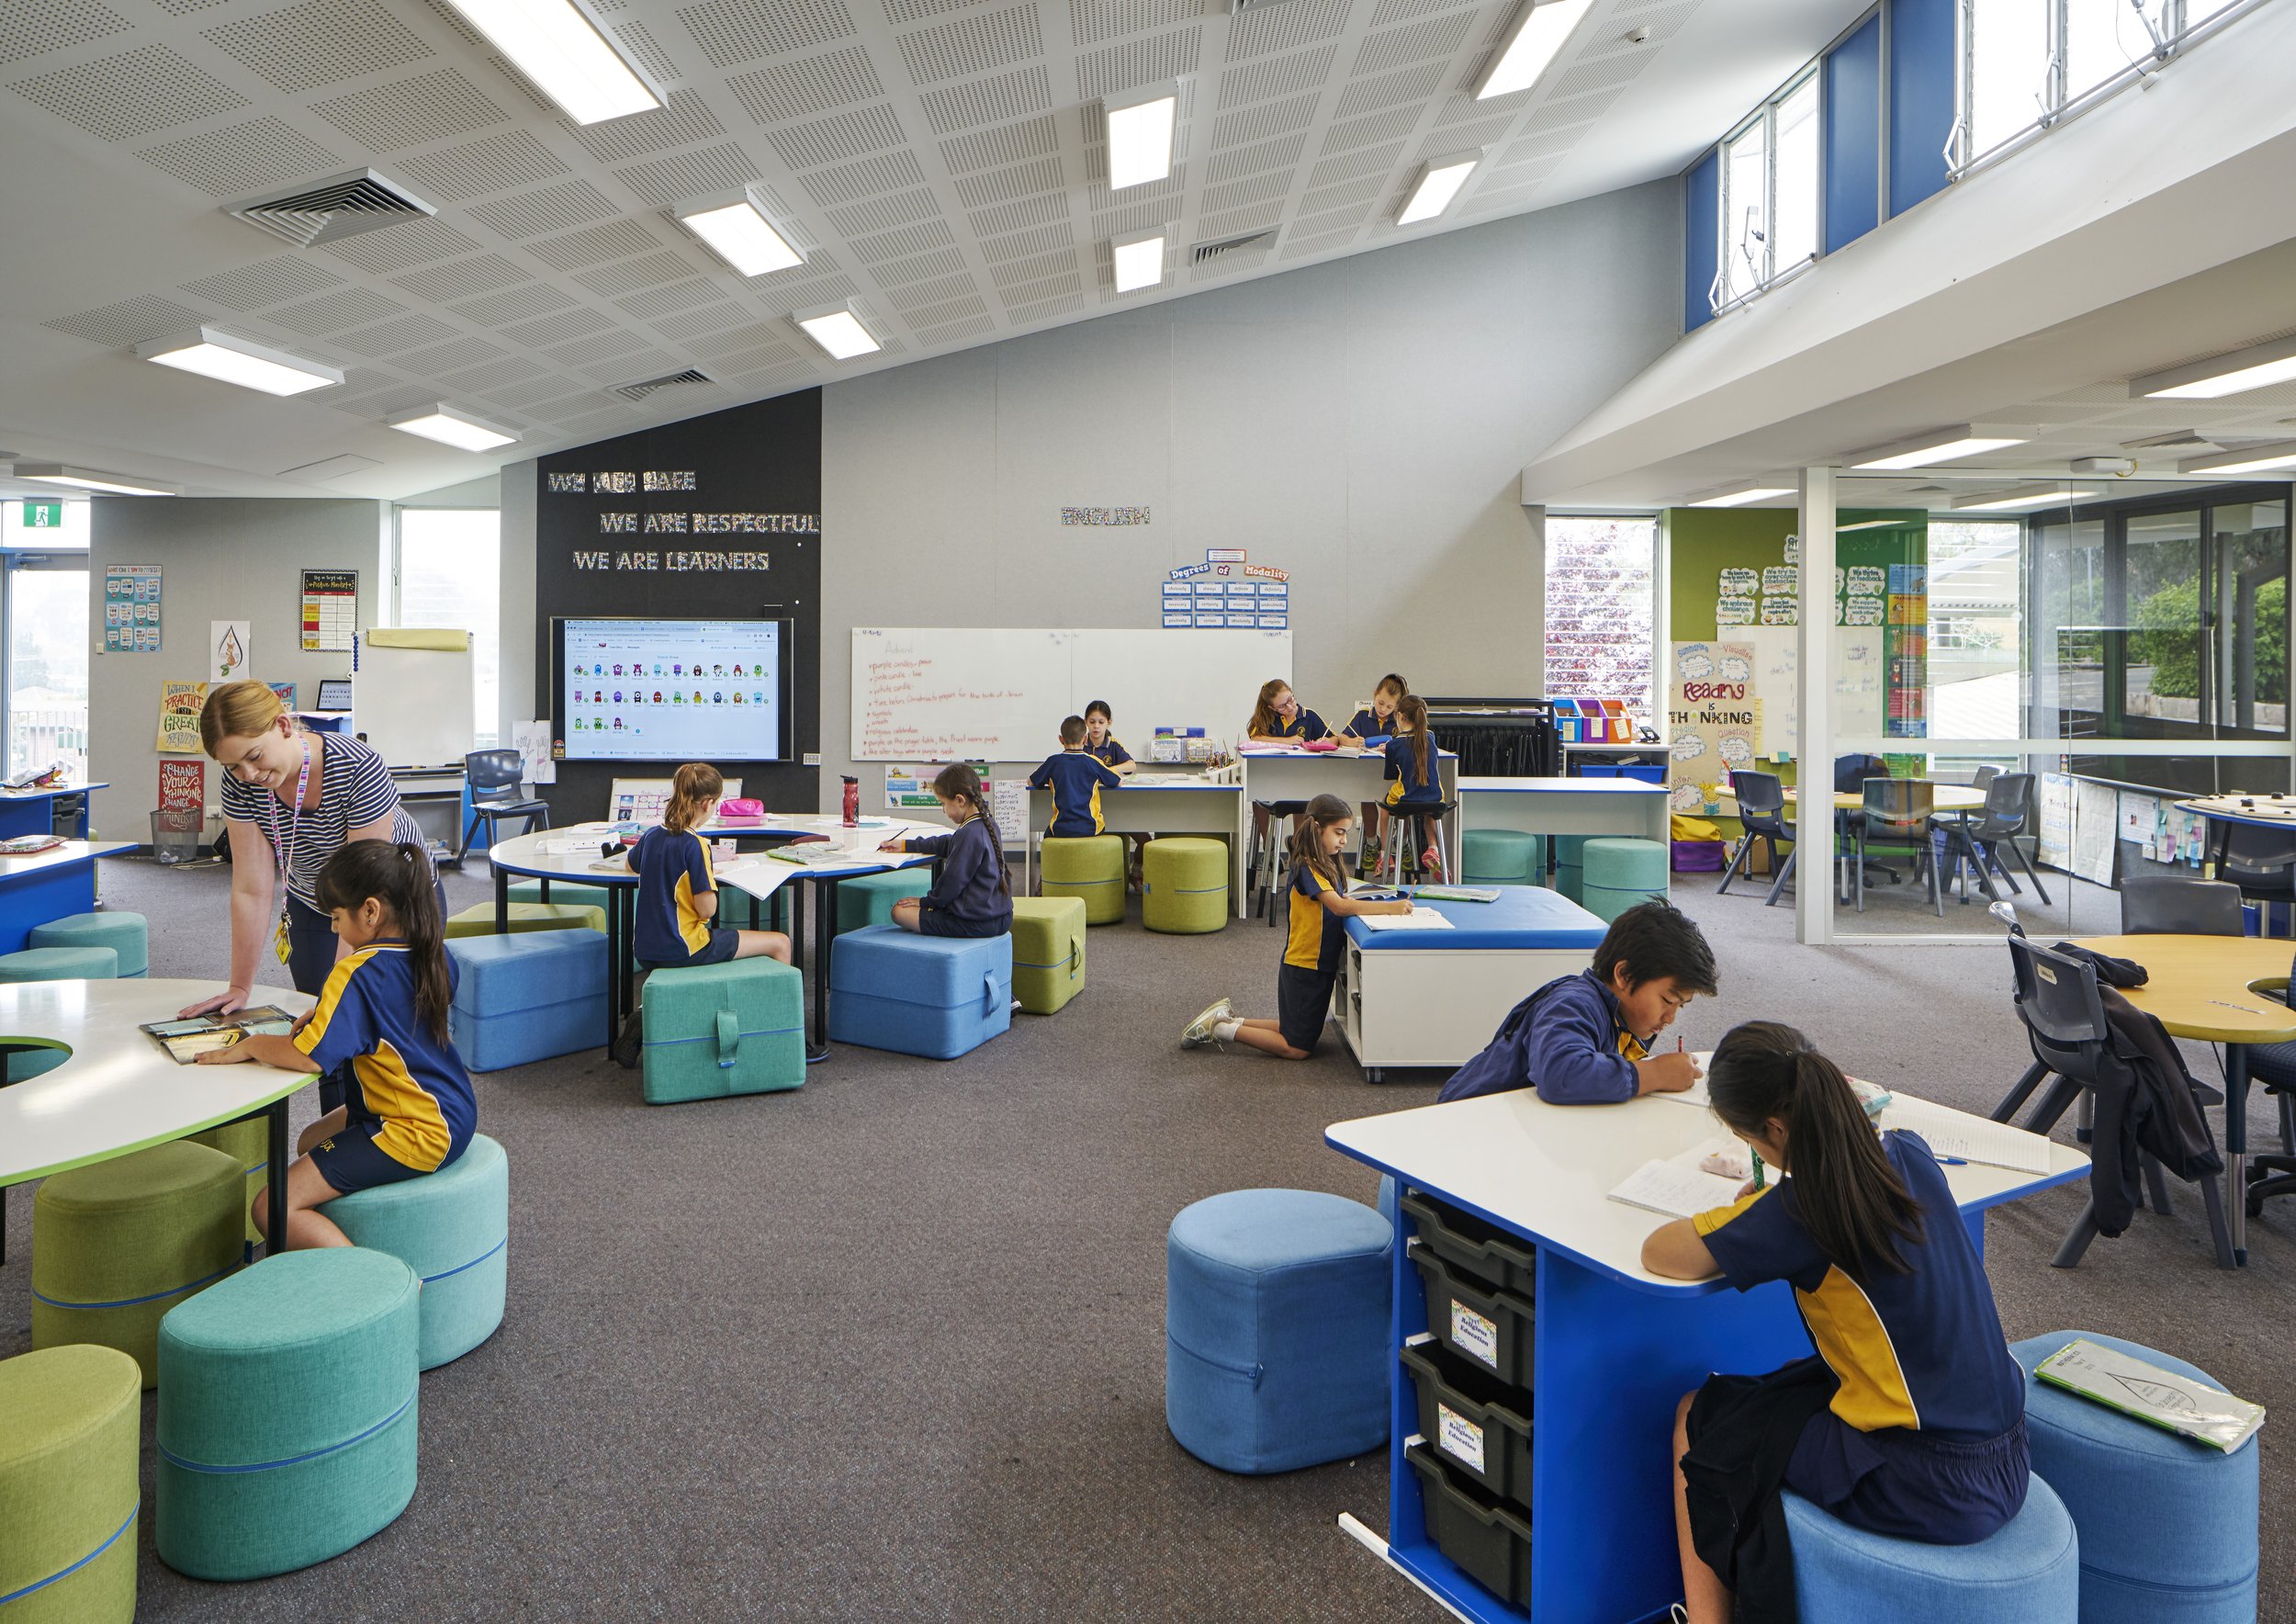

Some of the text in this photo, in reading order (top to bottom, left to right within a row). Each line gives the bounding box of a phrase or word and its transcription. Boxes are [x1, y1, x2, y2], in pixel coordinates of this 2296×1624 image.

[548, 473, 585, 492] WE
[601, 513, 820, 534] WE ARE RESPECTFUL
[1062, 507, 1150, 525] ENGLISH
[573, 552, 770, 570] WE ARE LEARNERS
[1171, 563, 1289, 581] Degrees of Modality
[872, 661, 893, 674] purple
[167, 684, 190, 695] WHEN
[1683, 682, 1745, 702] Reading
[165, 694, 203, 710] PRACTICE
[164, 716, 200, 733] GREAT
[1718, 727, 1750, 738] Question
[163, 763, 199, 777] CHANGE
[163, 773, 199, 790] YOUR
[165, 796, 190, 807] CHANGE
[1461, 1316, 1488, 1337] Religious
[1460, 1325, 1489, 1347] Education
[1448, 1422, 1475, 1442] Religious
[1448, 1430, 1477, 1452] Education
